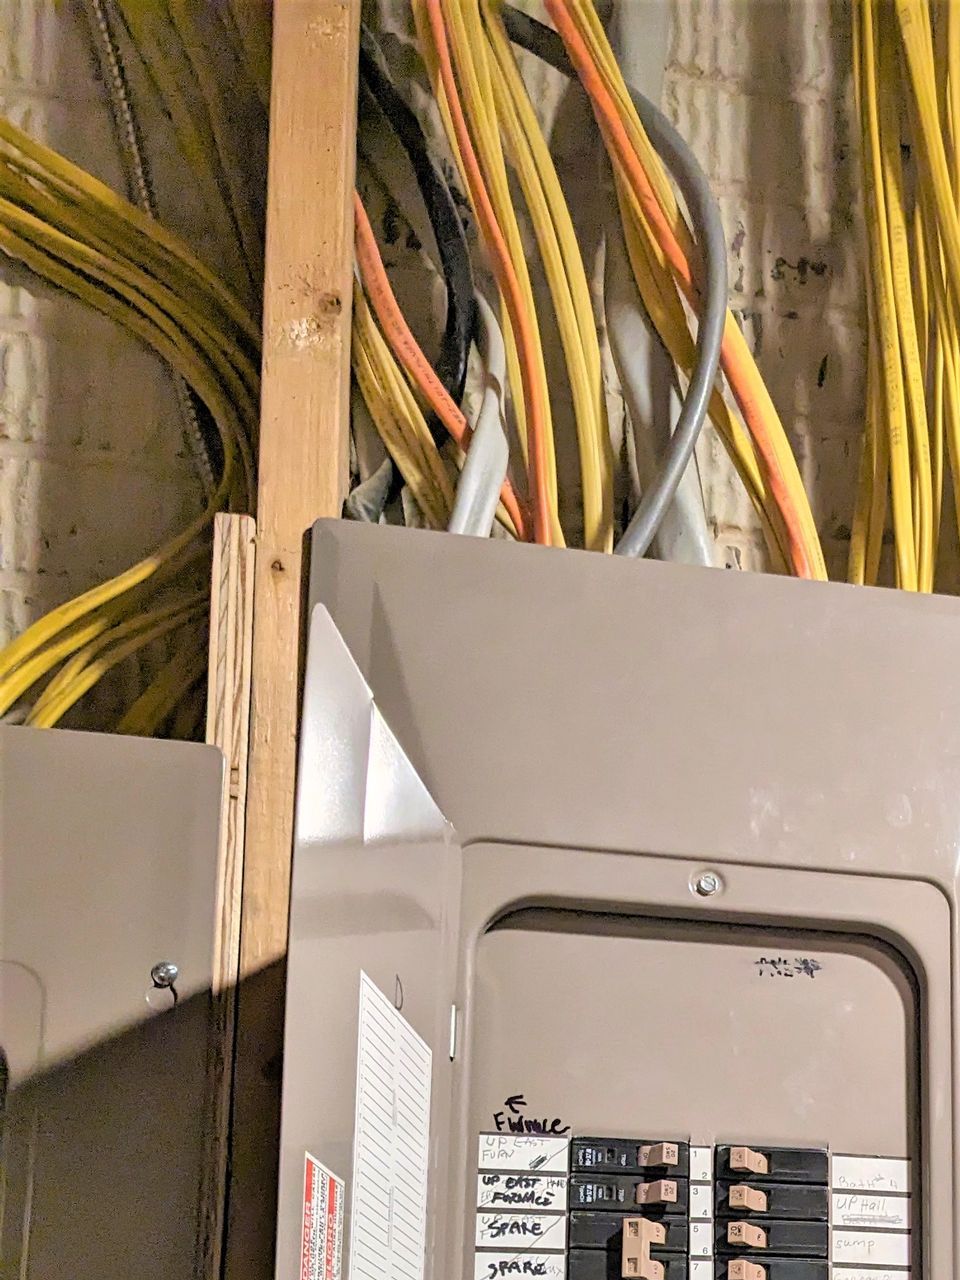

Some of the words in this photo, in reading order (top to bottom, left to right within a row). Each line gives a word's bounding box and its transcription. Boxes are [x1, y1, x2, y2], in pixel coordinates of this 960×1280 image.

[482, 1176, 500, 1186] UP
[836, 1196, 857, 1209] UP
[488, 1220, 543, 1238] SPARE
[303, 1201, 312, 1280] DANGER
[488, 1261, 548, 1279] SPARE
